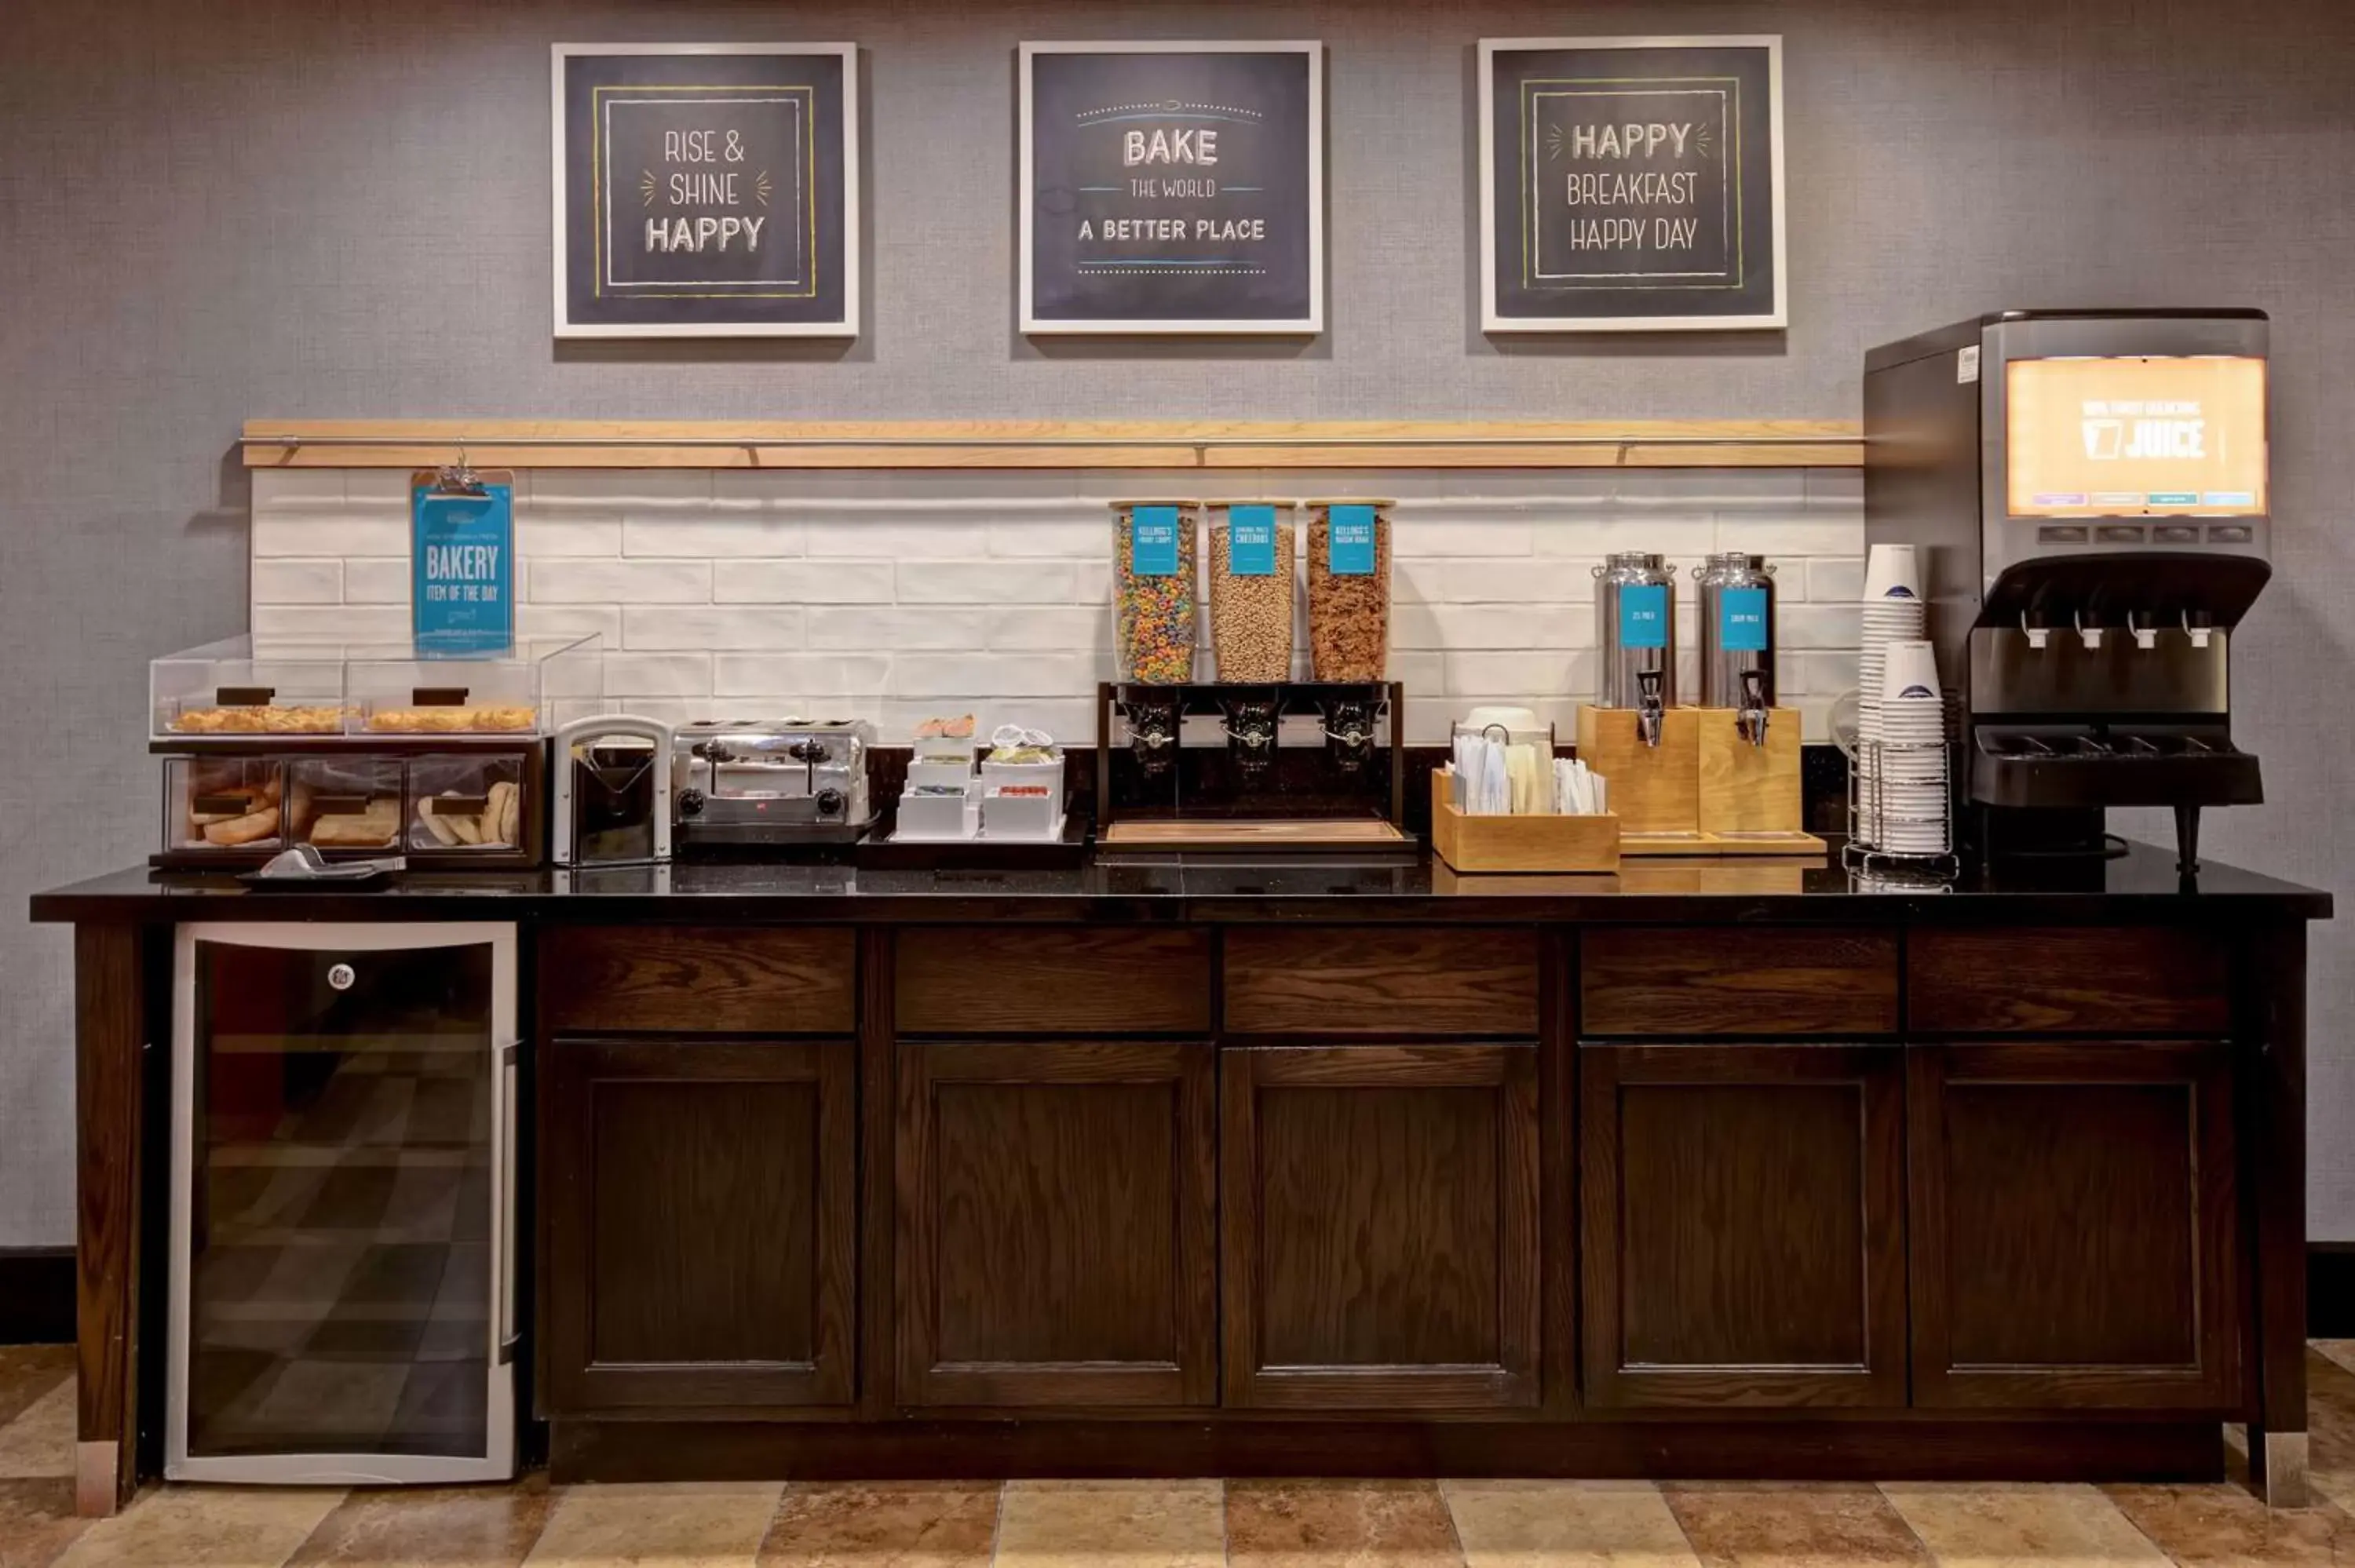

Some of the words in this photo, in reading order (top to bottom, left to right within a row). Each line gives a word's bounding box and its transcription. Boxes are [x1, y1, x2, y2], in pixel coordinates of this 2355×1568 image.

[665, 130, 716, 162] RISE
[725, 129, 745, 162] &
[1123, 129, 1218, 167] BAKE
[1572, 123, 1692, 159] HAPPY
[670, 173, 740, 205] SHINE
[1130, 179, 1157, 198] THE
[1163, 178, 1216, 198] WORLD
[1567, 172, 1697, 206] BREAKFAST
[644, 216, 765, 253] HAPPY
[1078, 219, 1094, 241] A
[1103, 219, 1186, 241] BETTER
[1195, 219, 1265, 241] PLACE
[1571, 218, 1646, 250] HAPPY
[1655, 217, 1698, 250] DAY
[2124, 419, 2207, 460] JUICE
[426, 545, 499, 581] BAKERY
[426, 585, 447, 602] ITEM
[448, 585, 462, 602] OF
[463, 585, 480, 602] THE
[481, 585, 498, 602] DAY
